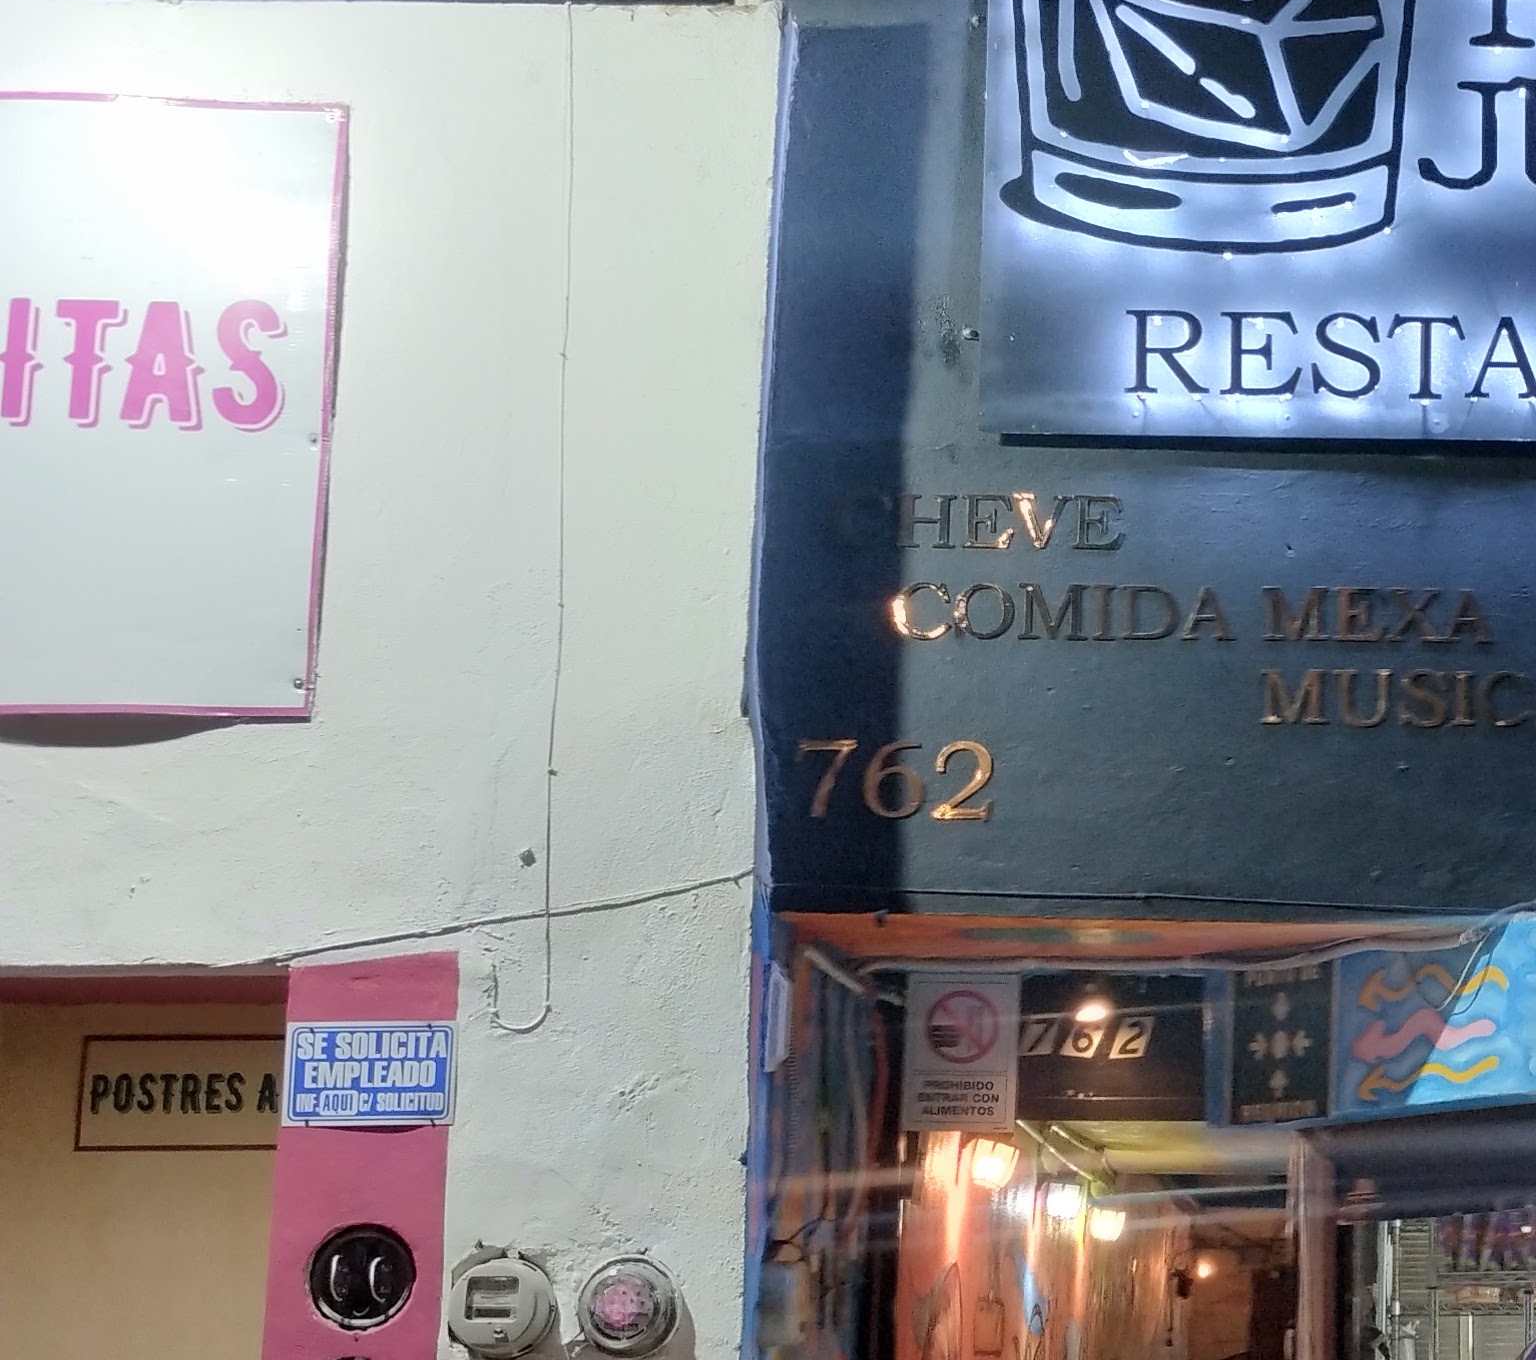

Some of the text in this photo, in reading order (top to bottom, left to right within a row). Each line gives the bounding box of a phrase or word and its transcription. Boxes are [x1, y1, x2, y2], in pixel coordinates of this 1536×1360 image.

[889, 582, 1494, 644] COMIDA MEXA
[795, 737, 994, 822] 762
[297, 1031, 447, 1060] SE SOLICITA
[304, 1060, 437, 1088] EMPLEADO
[924, 1080, 995, 1091] PROHIBIDO
[90, 1072, 247, 1115] POSTRES
[376, 1091, 445, 1112] SOLICITUD
[917, 1092, 1000, 1104] ENTRAR CON
[921, 1106, 995, 1116] ALIMENTOS
